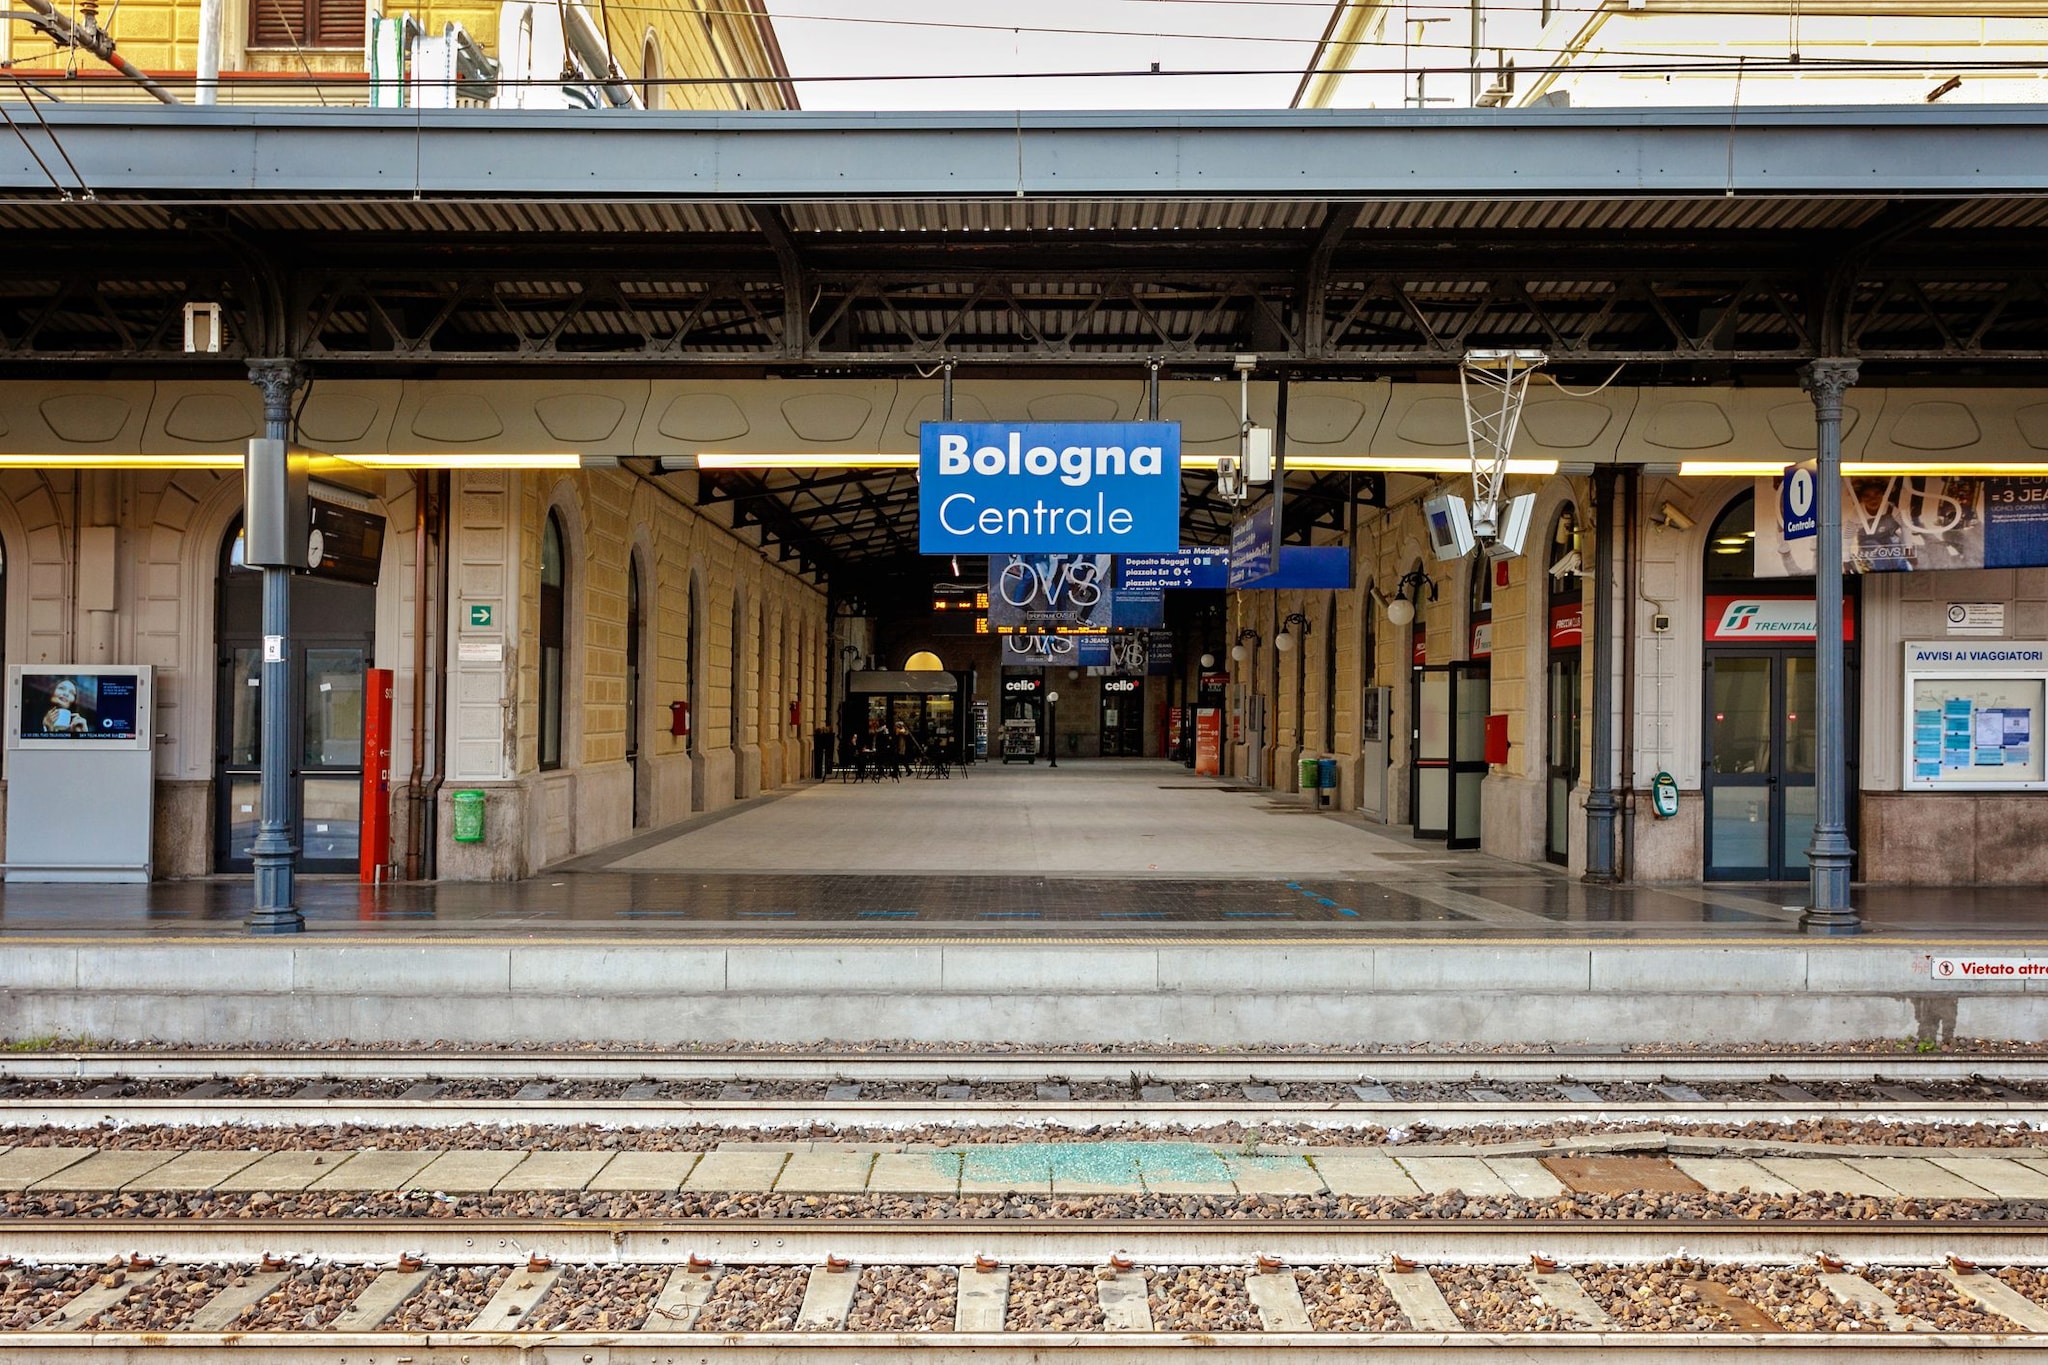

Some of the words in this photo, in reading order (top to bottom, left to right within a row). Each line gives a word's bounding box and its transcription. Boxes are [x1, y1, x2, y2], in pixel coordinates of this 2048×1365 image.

[939, 431, 1162, 487] Bologna
[1797, 480, 1804, 505] 1
[2003, 489, 2014, 503] 3
[939, 491, 1134, 536] Centrale
[1787, 519, 1816, 533] Centrale
[1193, 547, 1229, 556] Medaglie
[1126, 558, 1159, 566] Deposito
[1160, 558, 1189, 567] Bagagli
[1126, 568, 1157, 577] piazzale
[999, 562, 1102, 606] OVS
[1126, 579, 1157, 587] piazzale
[1755, 622, 1818, 631] TRENITALI
[1111, 643, 1144, 666] VS
[1916, 651, 1953, 661] AVVISI
[1955, 651, 1967, 661] AI
[1969, 651, 2043, 661] VIAGGIATORI
[1006, 680, 1035, 691] celio
[1105, 680, 1134, 691] celio
[1961, 962, 2015, 975] Vietato
